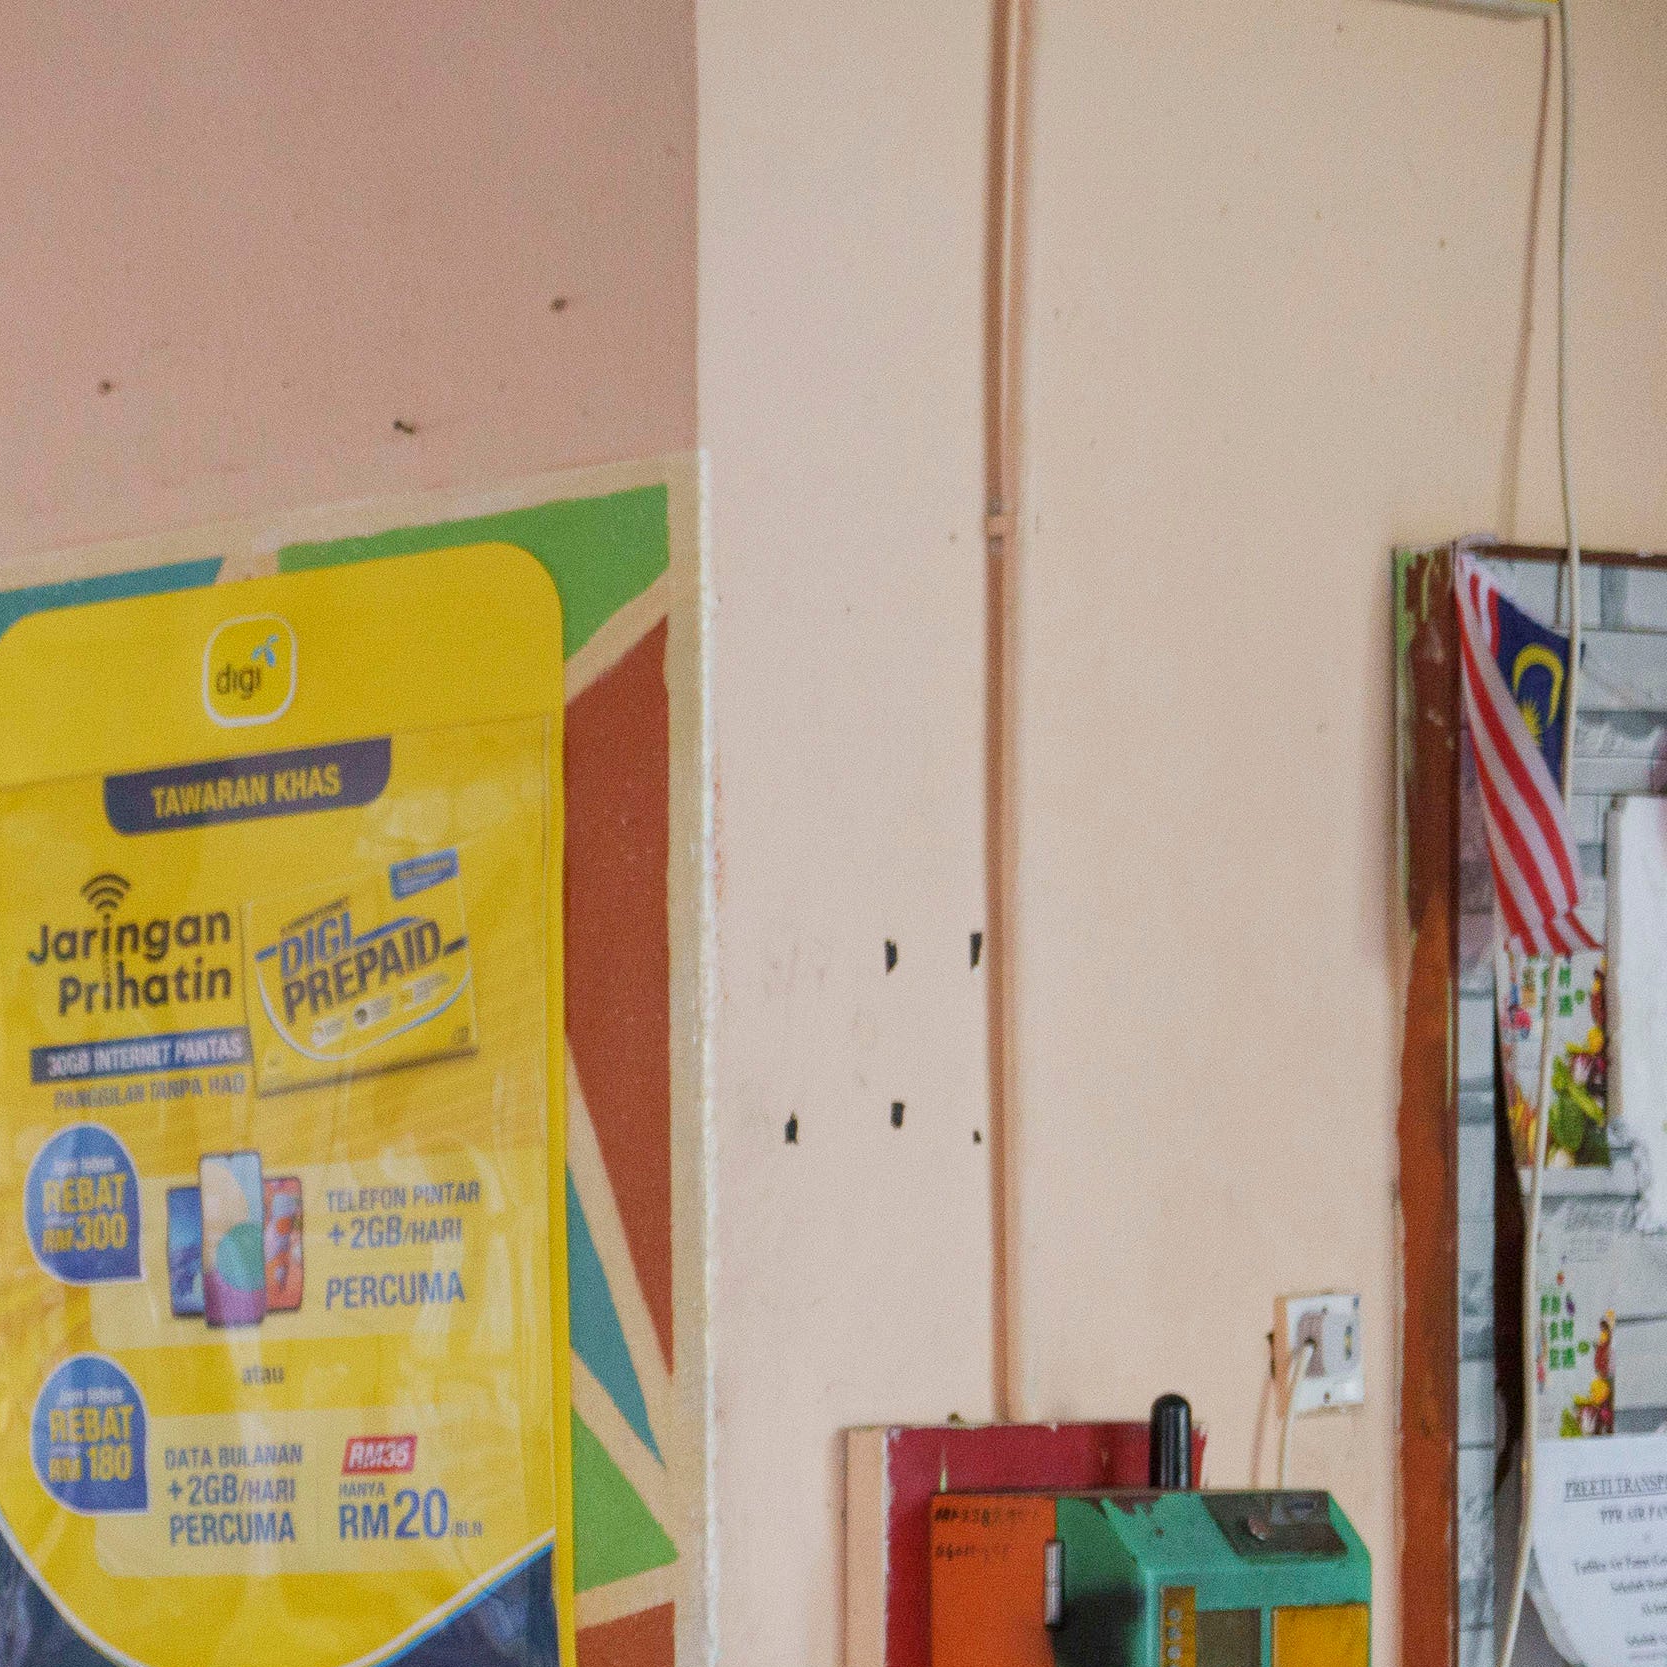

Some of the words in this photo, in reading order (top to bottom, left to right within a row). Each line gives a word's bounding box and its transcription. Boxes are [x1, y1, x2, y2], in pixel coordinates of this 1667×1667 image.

[216, 663, 262, 701] digi
[151, 774, 267, 818] TAWARAN
[273, 763, 342, 801] KHAS
[28, 911, 231, 966] Jaringan
[280, 911, 352, 979] DIGI
[58, 956, 232, 1016] Prihatin
[283, 920, 442, 1025] PREPAID
[93, 1041, 171, 1073] INTERNET
[174, 1033, 245, 1064] PANTAS
[43, 1173, 128, 1214] REBAT
[327, 1186, 407, 1212] TELEFON
[413, 1180, 480, 1206] PINTAR
[325, 1269, 466, 1310] PERCUMA
[49, 1405, 134, 1443] REBAT
[165, 1446, 213, 1470] DATA
[218, 1444, 303, 1467] BULANAN
[339, 1482, 385, 1498] HANYA
[170, 1511, 296, 1546] PERCUMA
